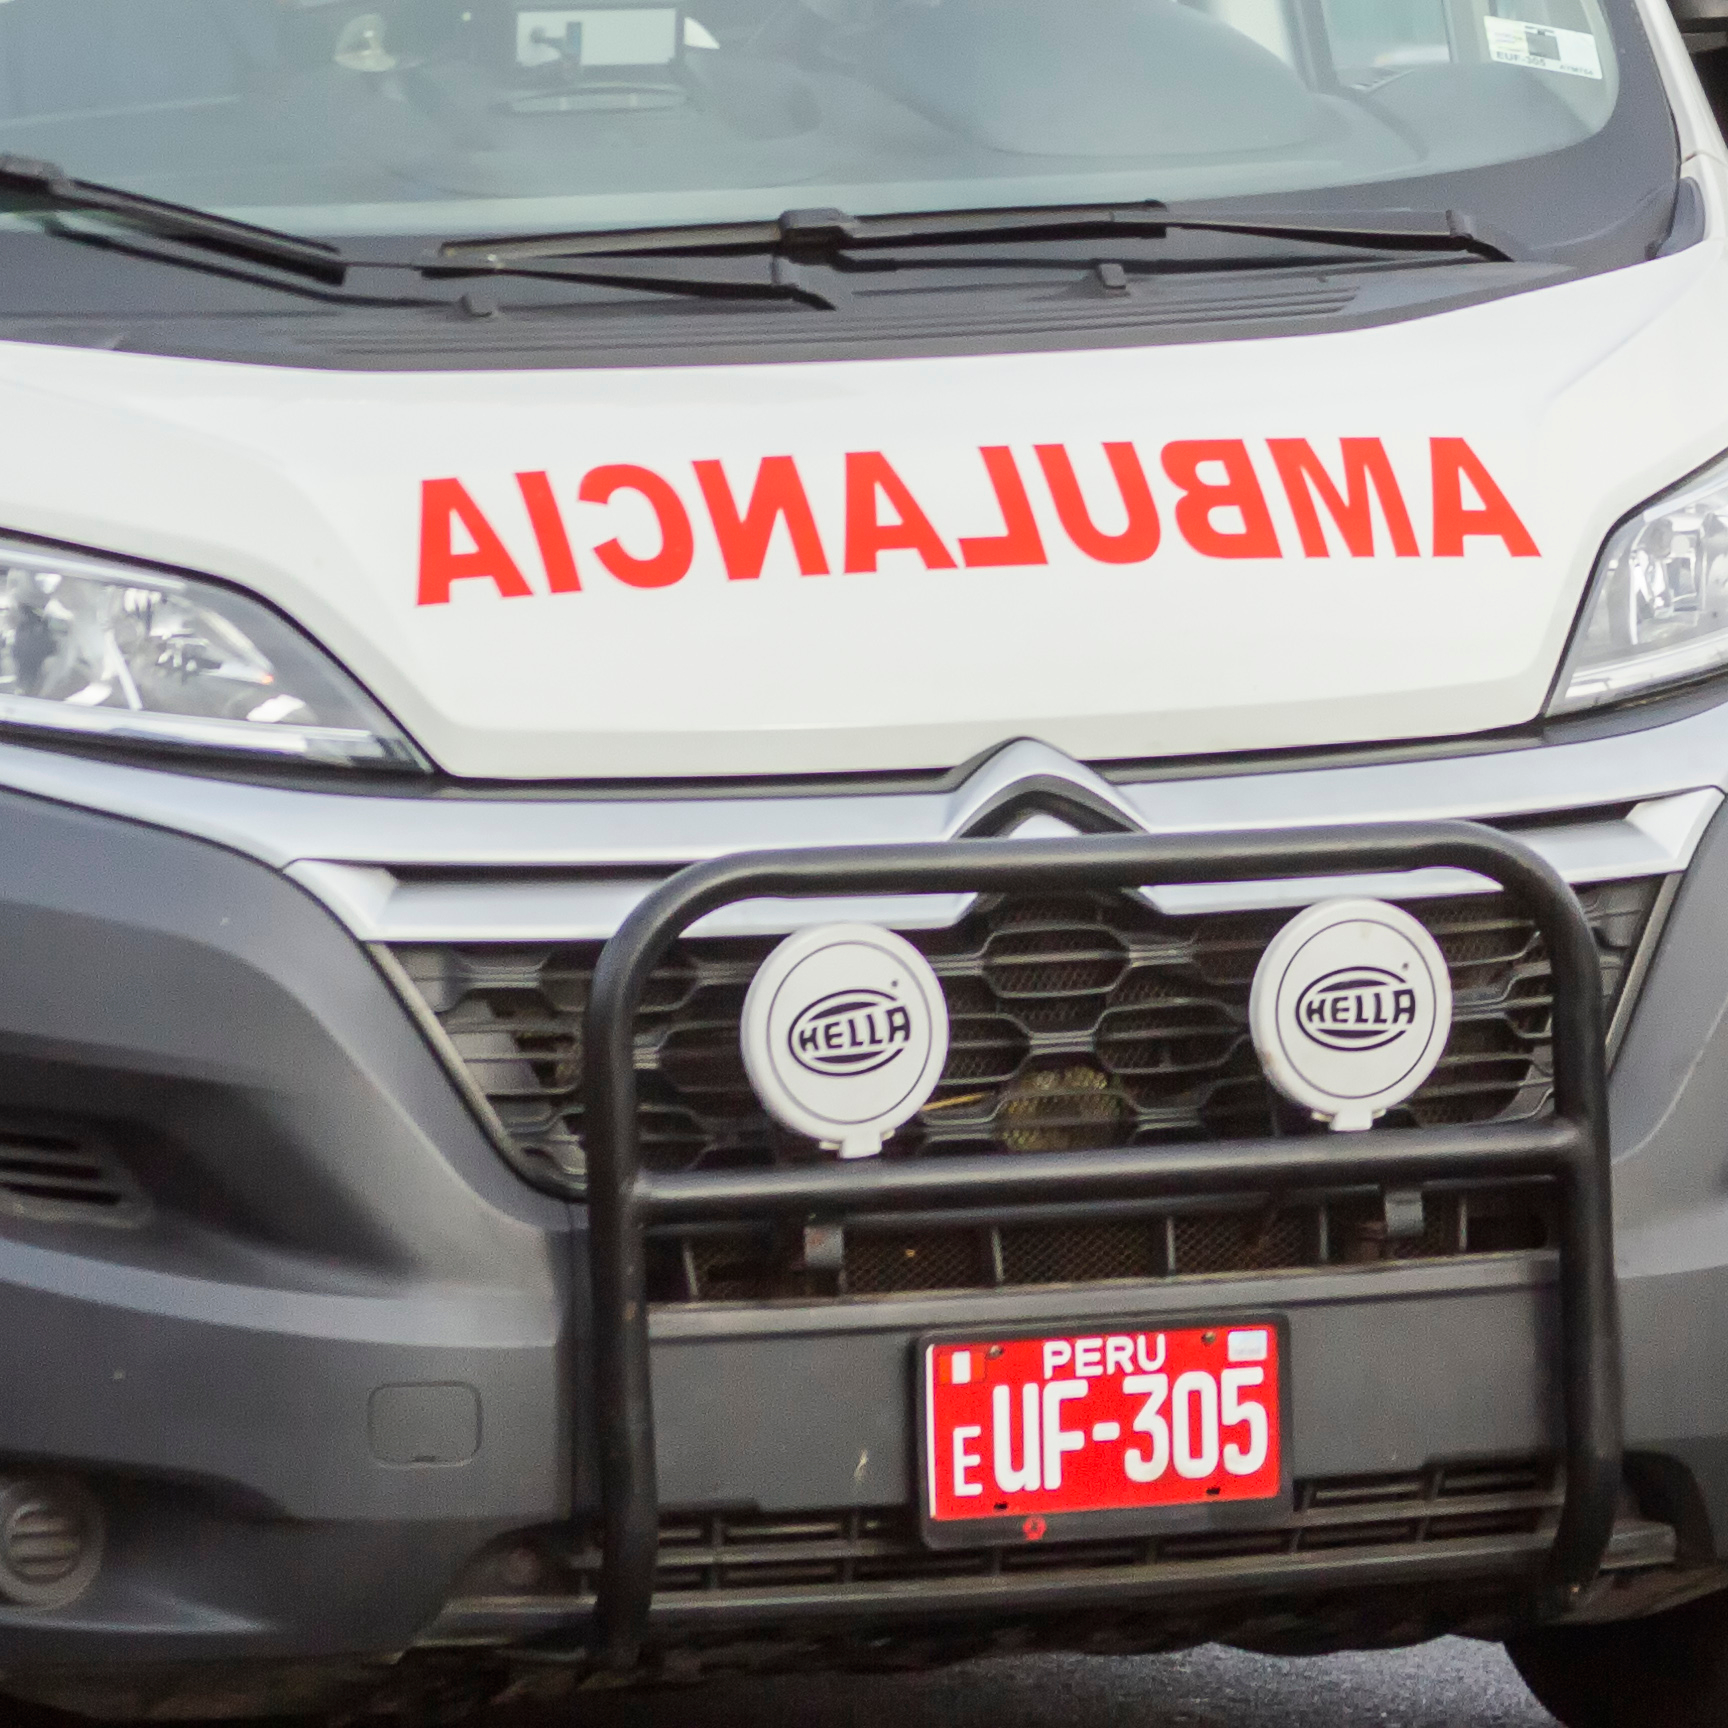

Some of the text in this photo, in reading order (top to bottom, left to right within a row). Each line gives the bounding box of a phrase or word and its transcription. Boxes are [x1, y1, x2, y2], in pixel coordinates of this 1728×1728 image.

[799, 1006, 911, 1052] HELLA
[1306, 988, 1416, 1024] HELLA
[1043, 1333, 1166, 1379] PERU
[992, 1365, 1269, 1494] UF-305
